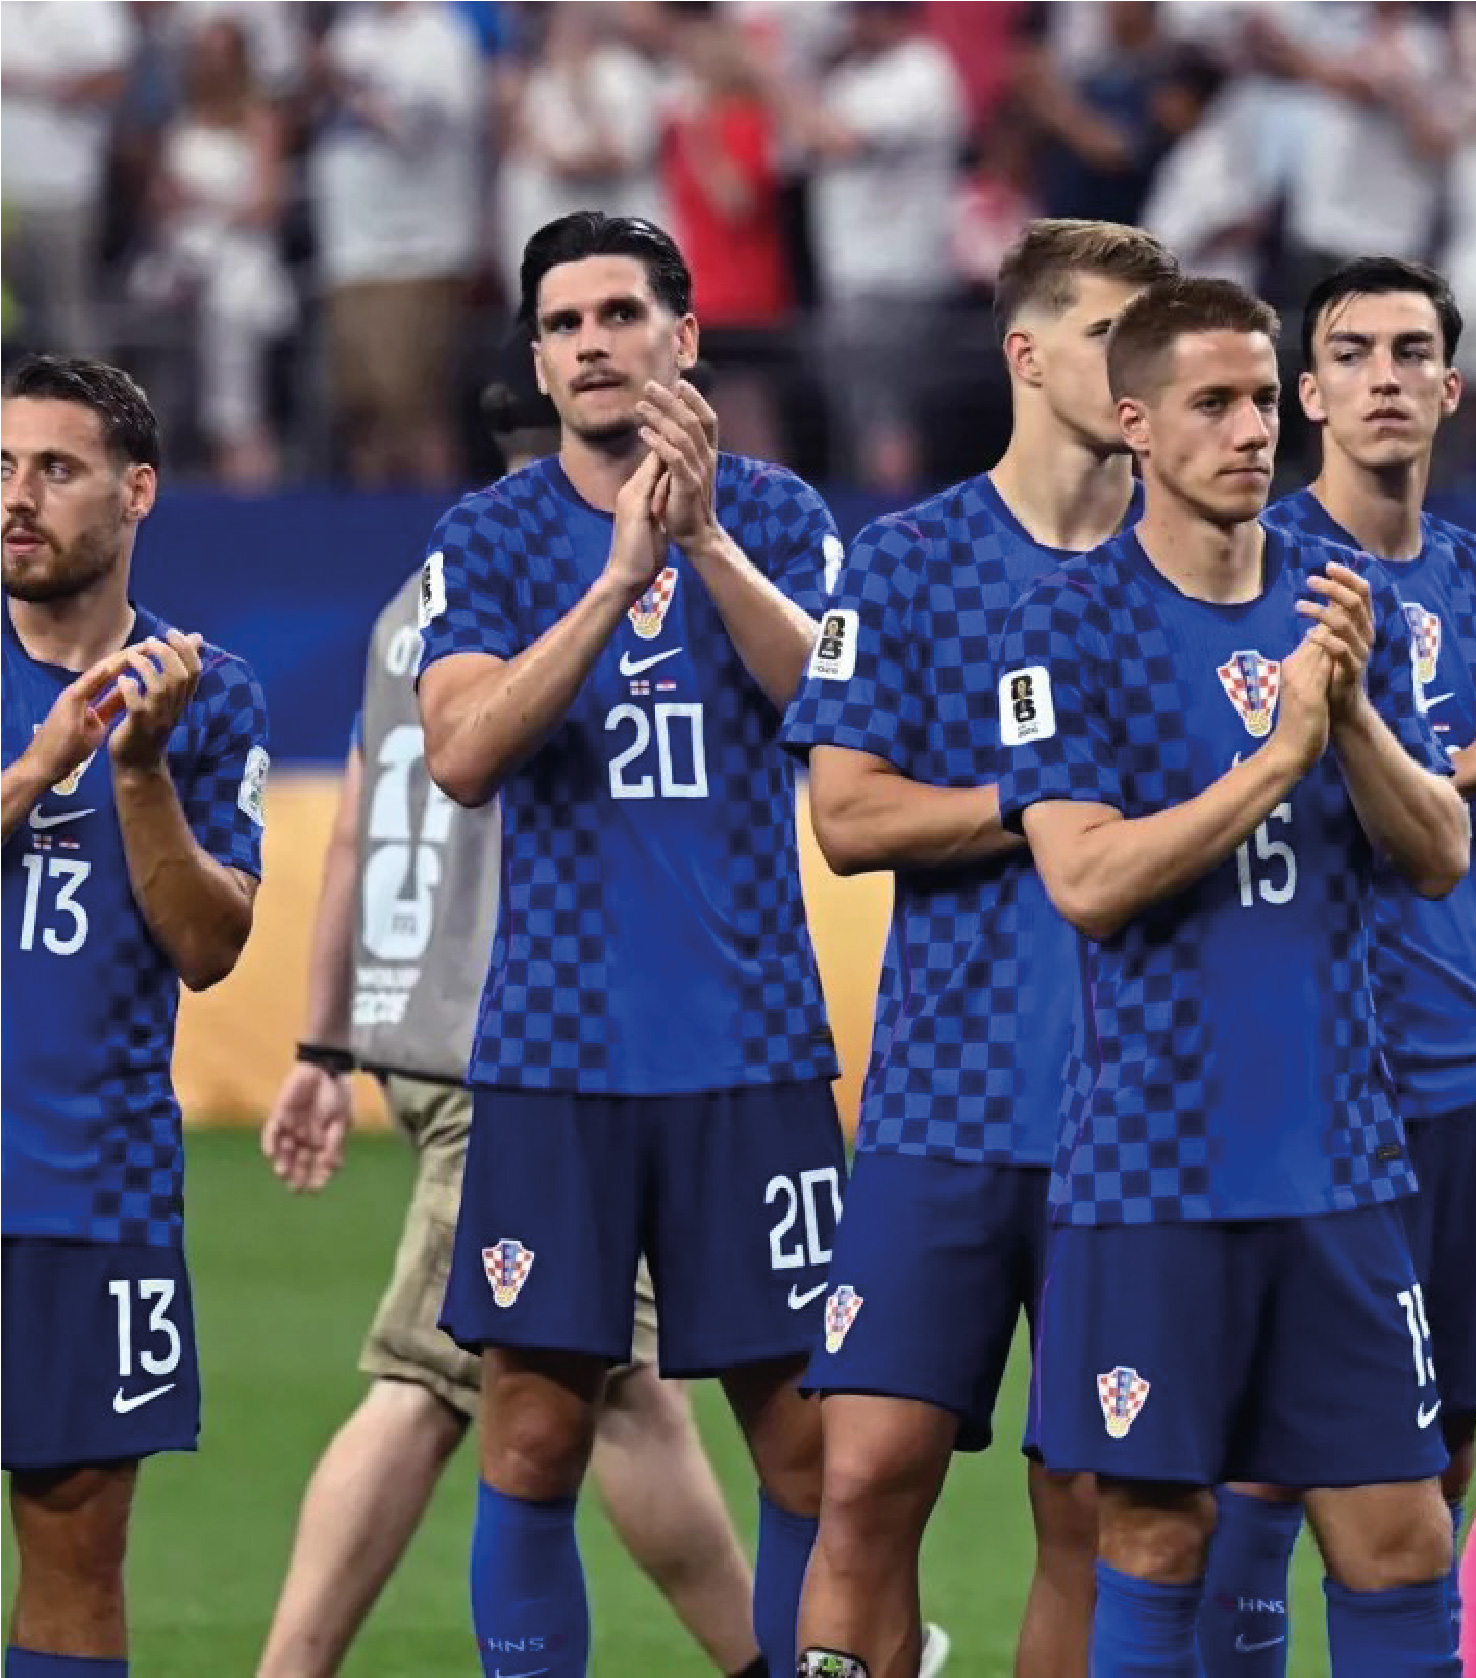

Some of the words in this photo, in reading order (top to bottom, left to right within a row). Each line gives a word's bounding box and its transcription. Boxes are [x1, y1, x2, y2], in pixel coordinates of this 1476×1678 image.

[604, 702, 709, 799] 20
[1236, 803, 1297, 907] 15
[20, 853, 91, 956] 13
[763, 1166, 844, 1270] 20
[108, 1278, 182, 1376] 13
[487, 1637, 544, 1653] HNS
[1238, 1596, 1285, 1614] HNS
